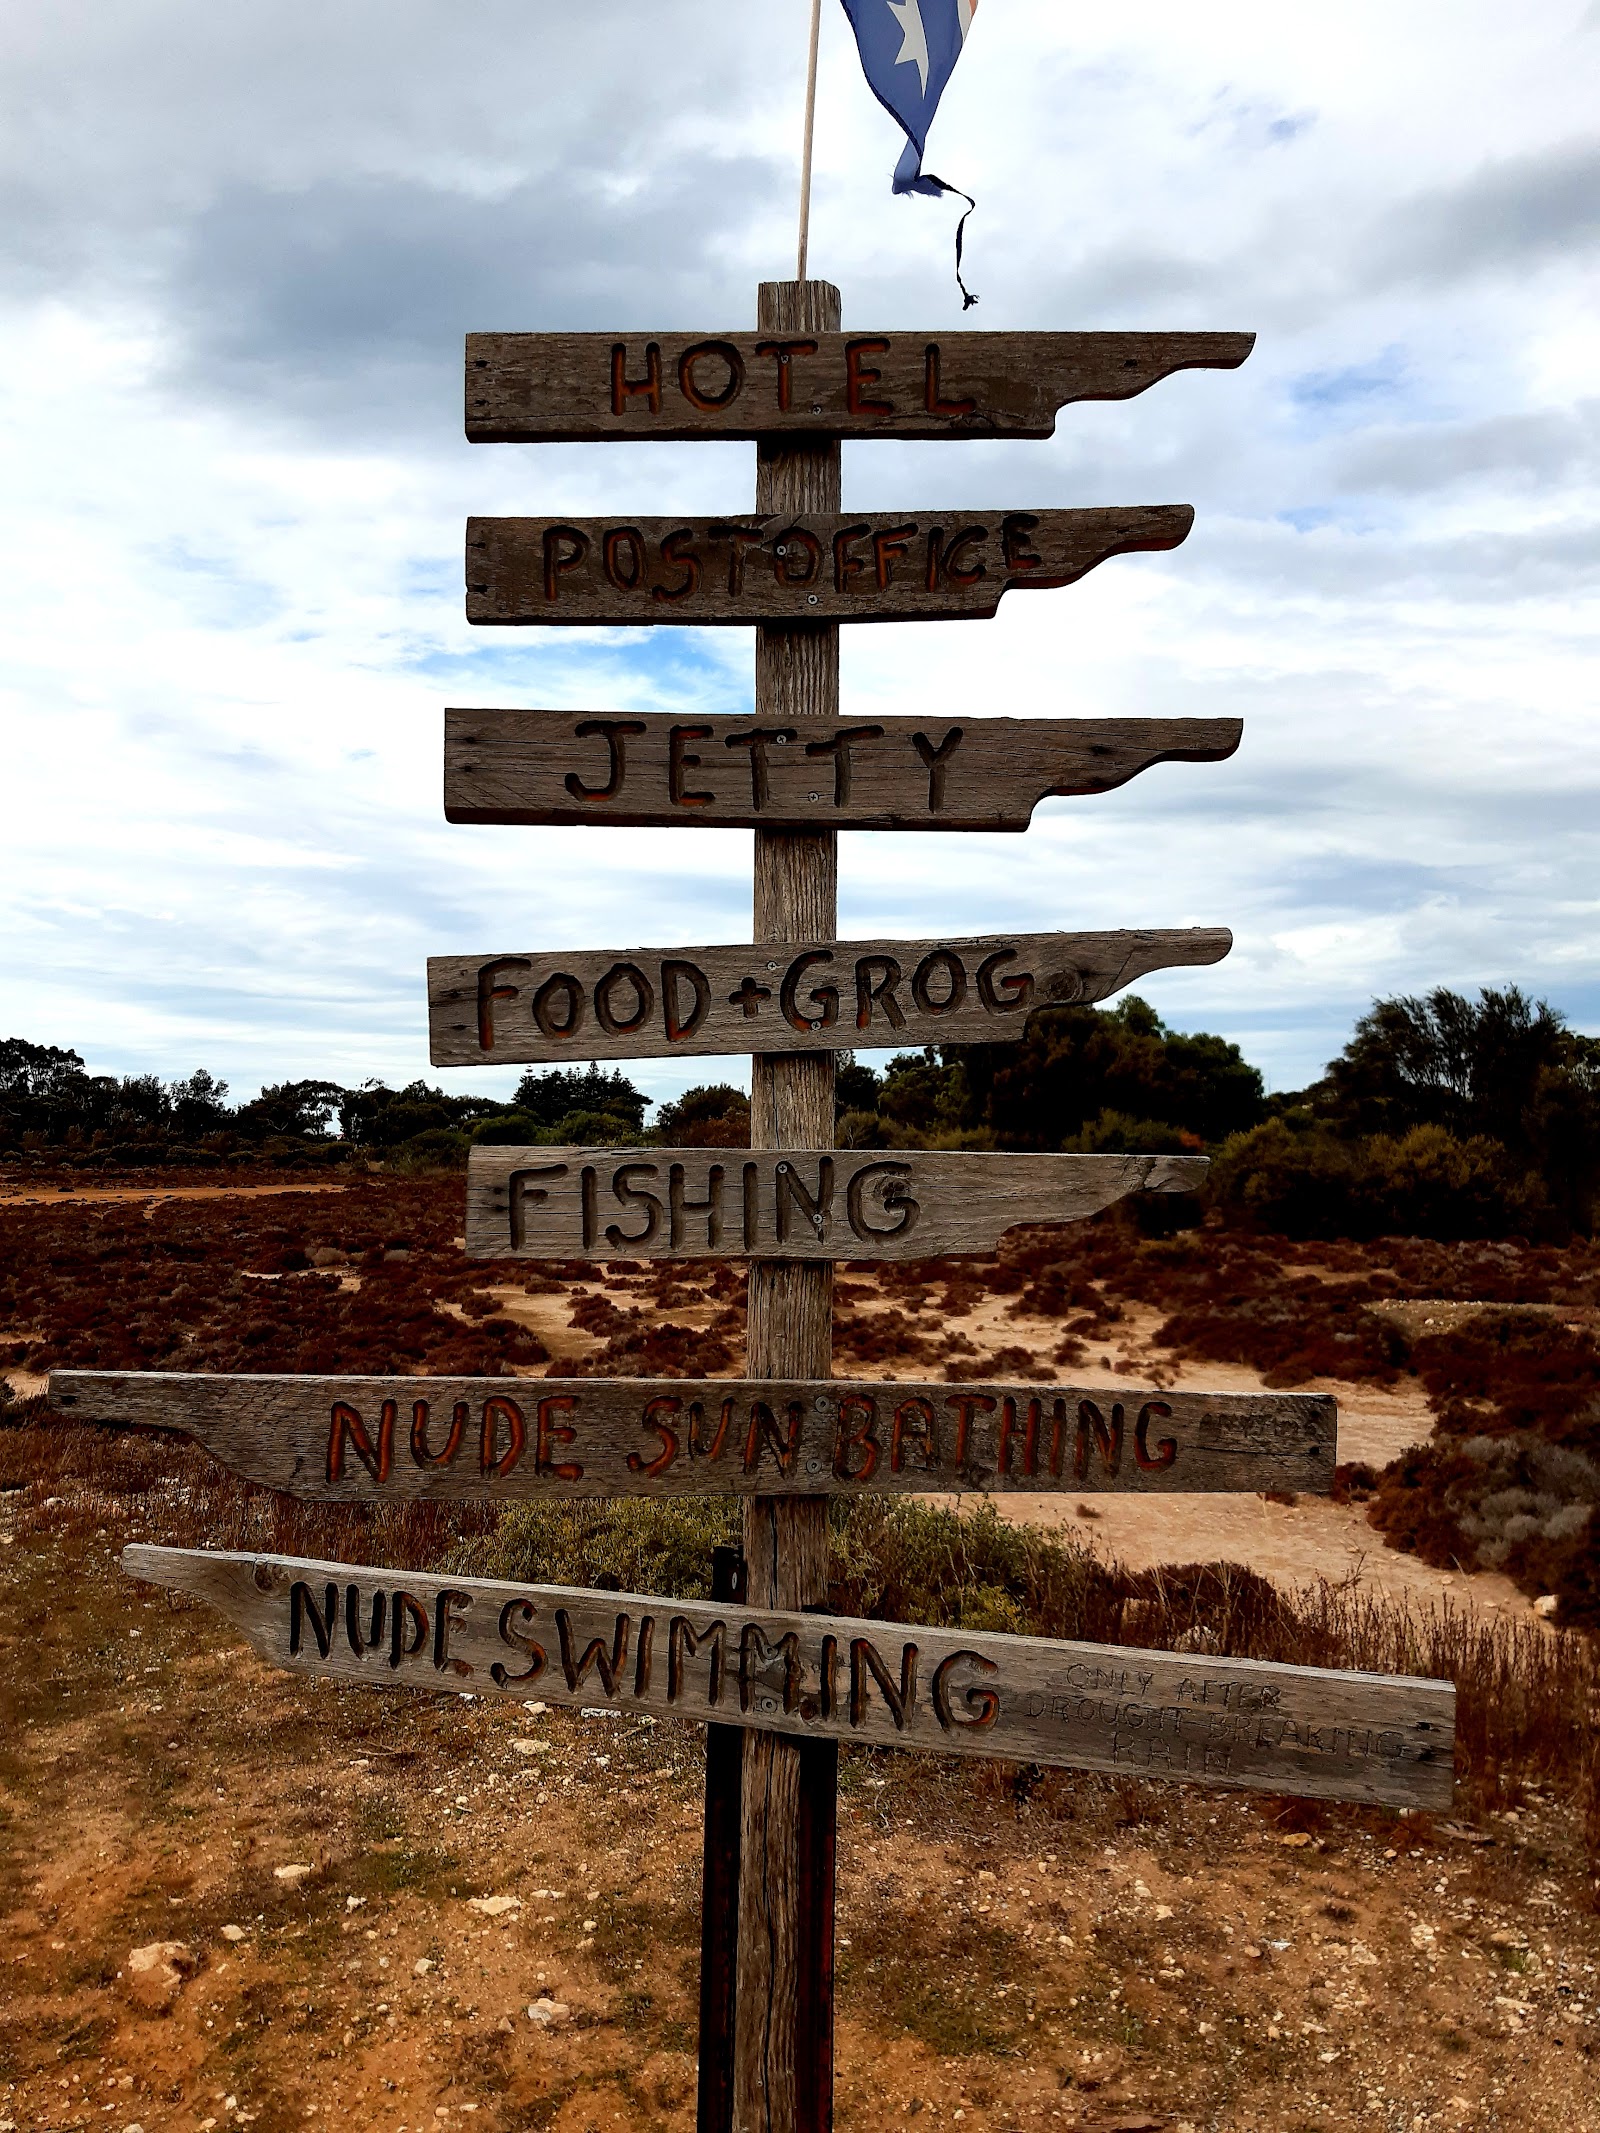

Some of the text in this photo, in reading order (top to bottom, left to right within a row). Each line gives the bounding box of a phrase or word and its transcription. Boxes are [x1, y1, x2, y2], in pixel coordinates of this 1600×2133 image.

[610, 339, 977, 415] HOTEL
[564, 720, 964, 813] JETTY
[509, 1154, 921, 1252] FISHING
[326, 1394, 1176, 1484] NUDE SUN BATHING
[290, 1581, 999, 1734] NUDE SWIMMING
[1067, 1663, 1282, 1708] ONLY AFTER
[1024, 1692, 1190, 1733] DROUGHT
[1113, 1731, 1233, 1776] RAIN
